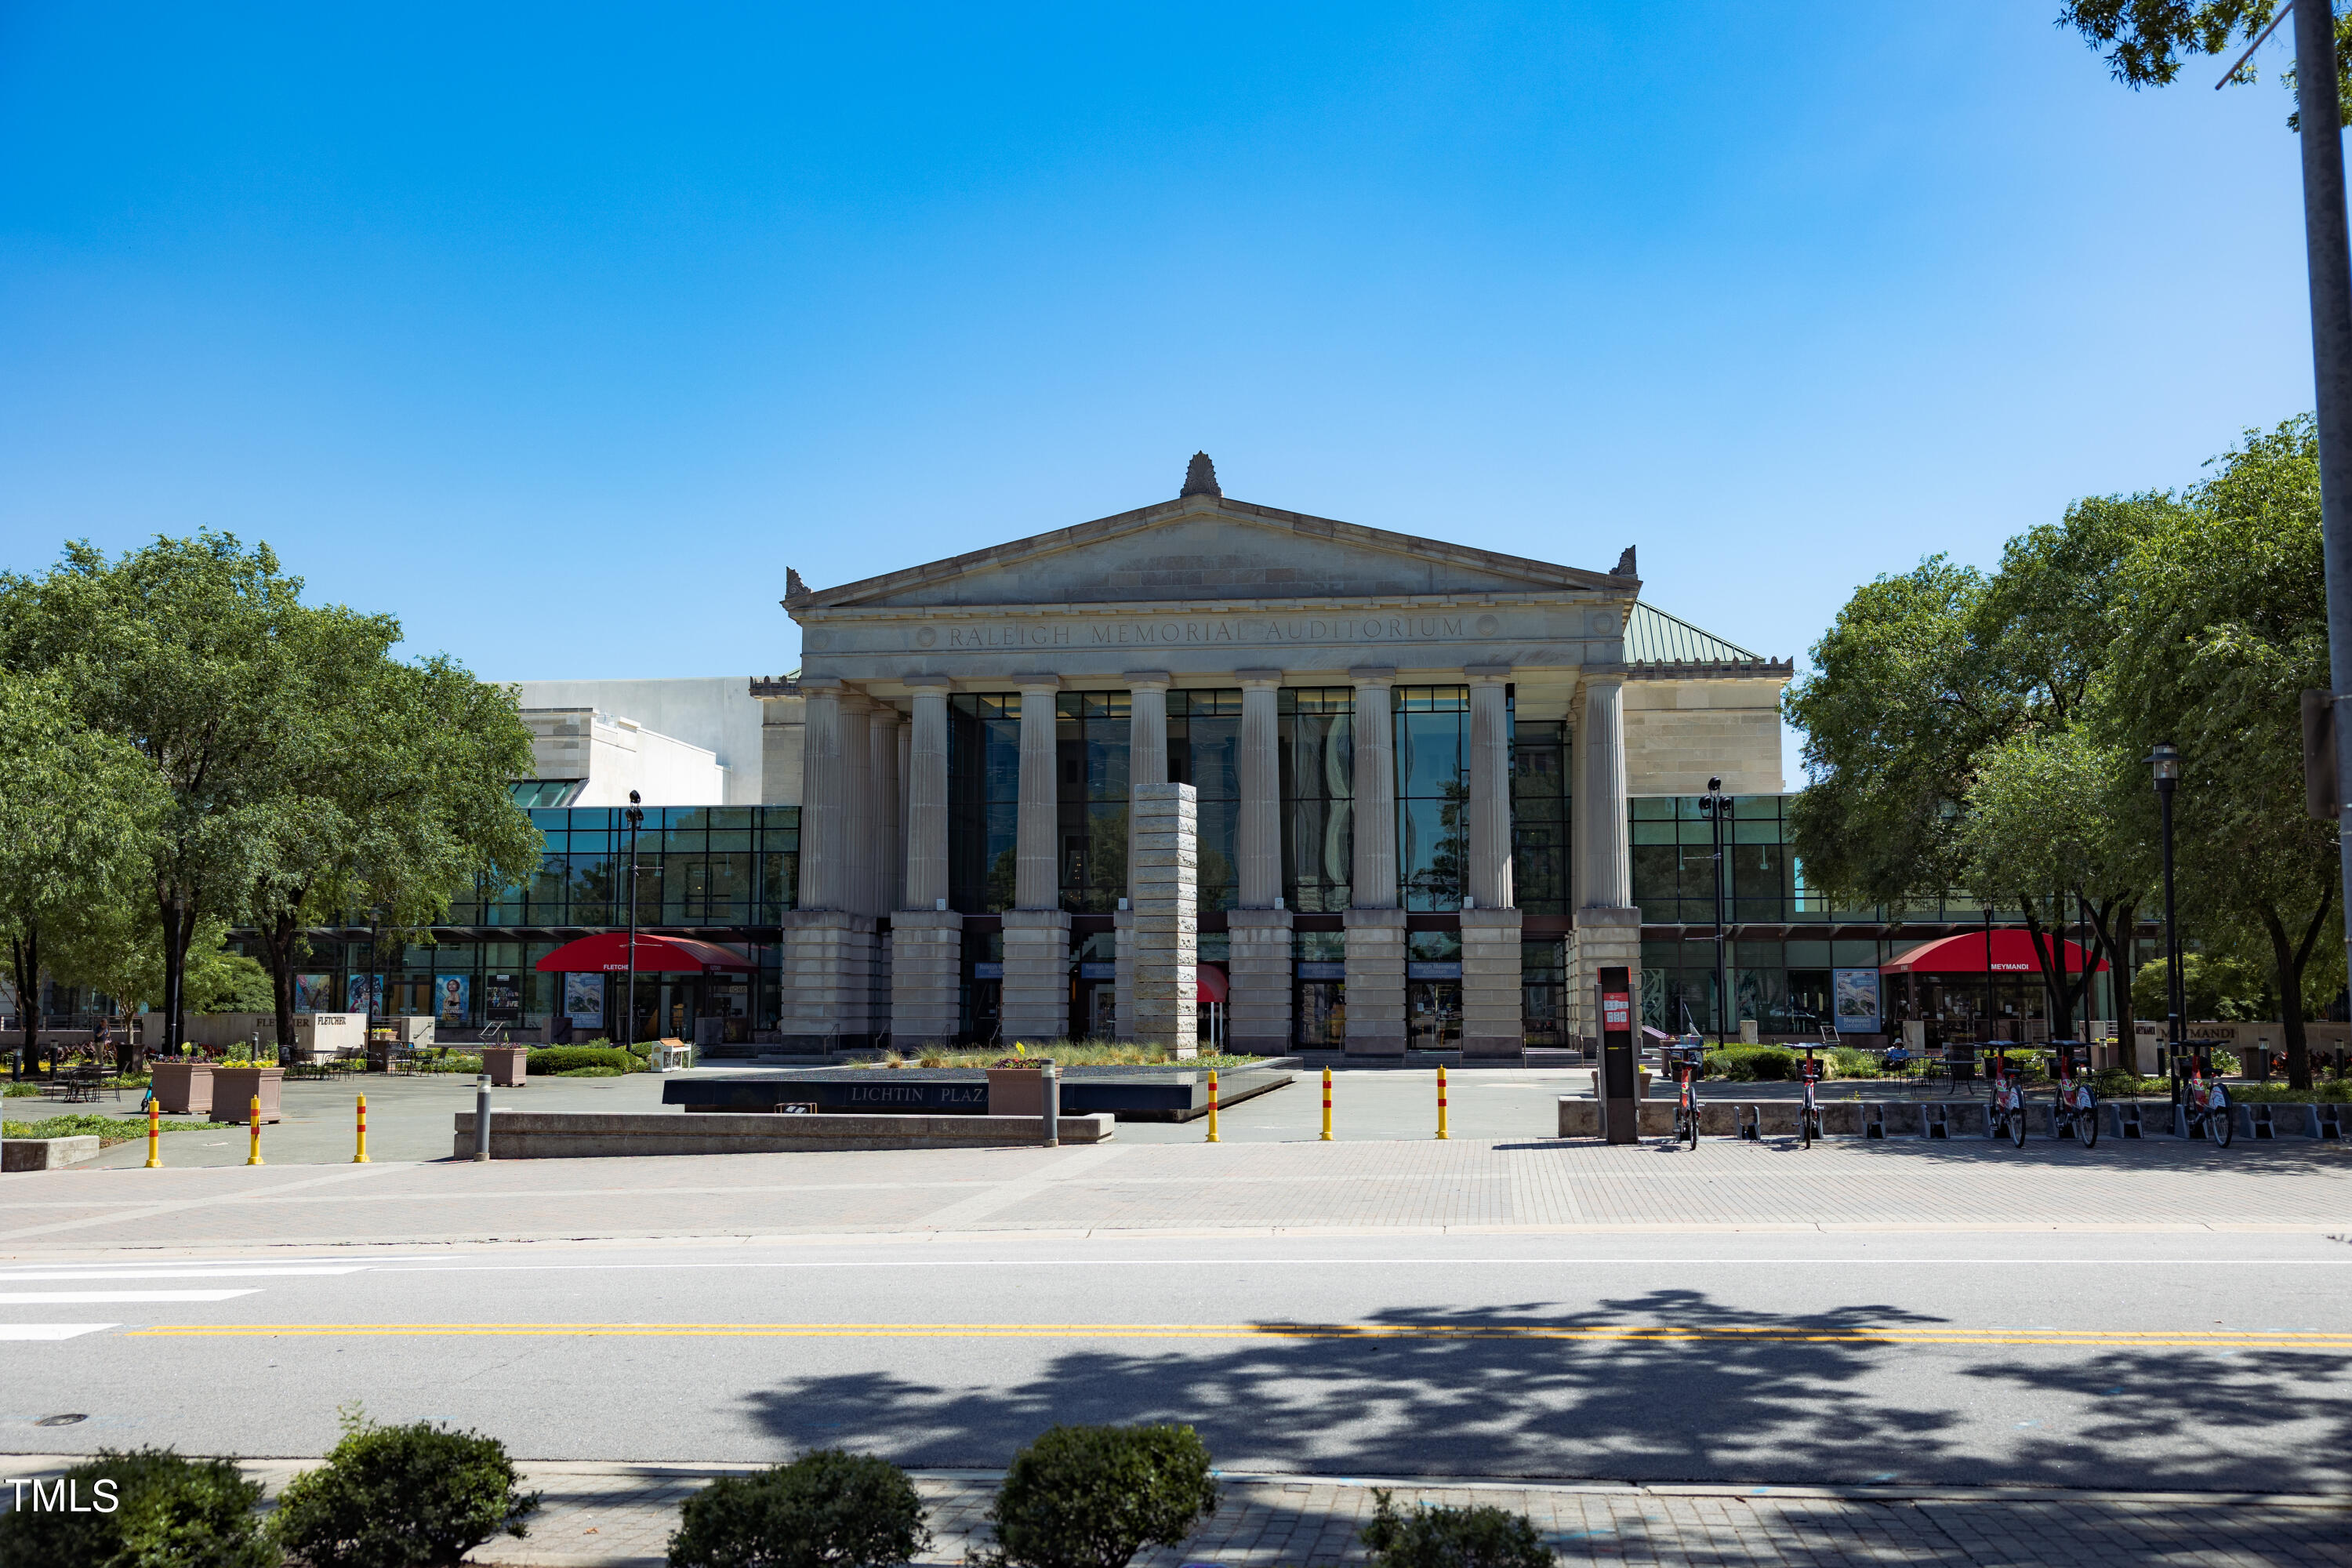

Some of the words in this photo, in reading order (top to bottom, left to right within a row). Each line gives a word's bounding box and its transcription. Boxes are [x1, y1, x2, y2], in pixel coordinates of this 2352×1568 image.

[949, 625, 1071, 646] RALEIGH
[1091, 620, 1248, 644] MEMORIAL
[1266, 617, 1464, 640] AUDITORIUM
[257, 1018, 310, 1027] FLEER
[318, 1017, 347, 1025] FLETCHER
[2160, 1028, 2235, 1038] MMANDI
[851, 1087, 925, 1102] LICHTIN
[941, 1087, 989, 1102] PLAZ
